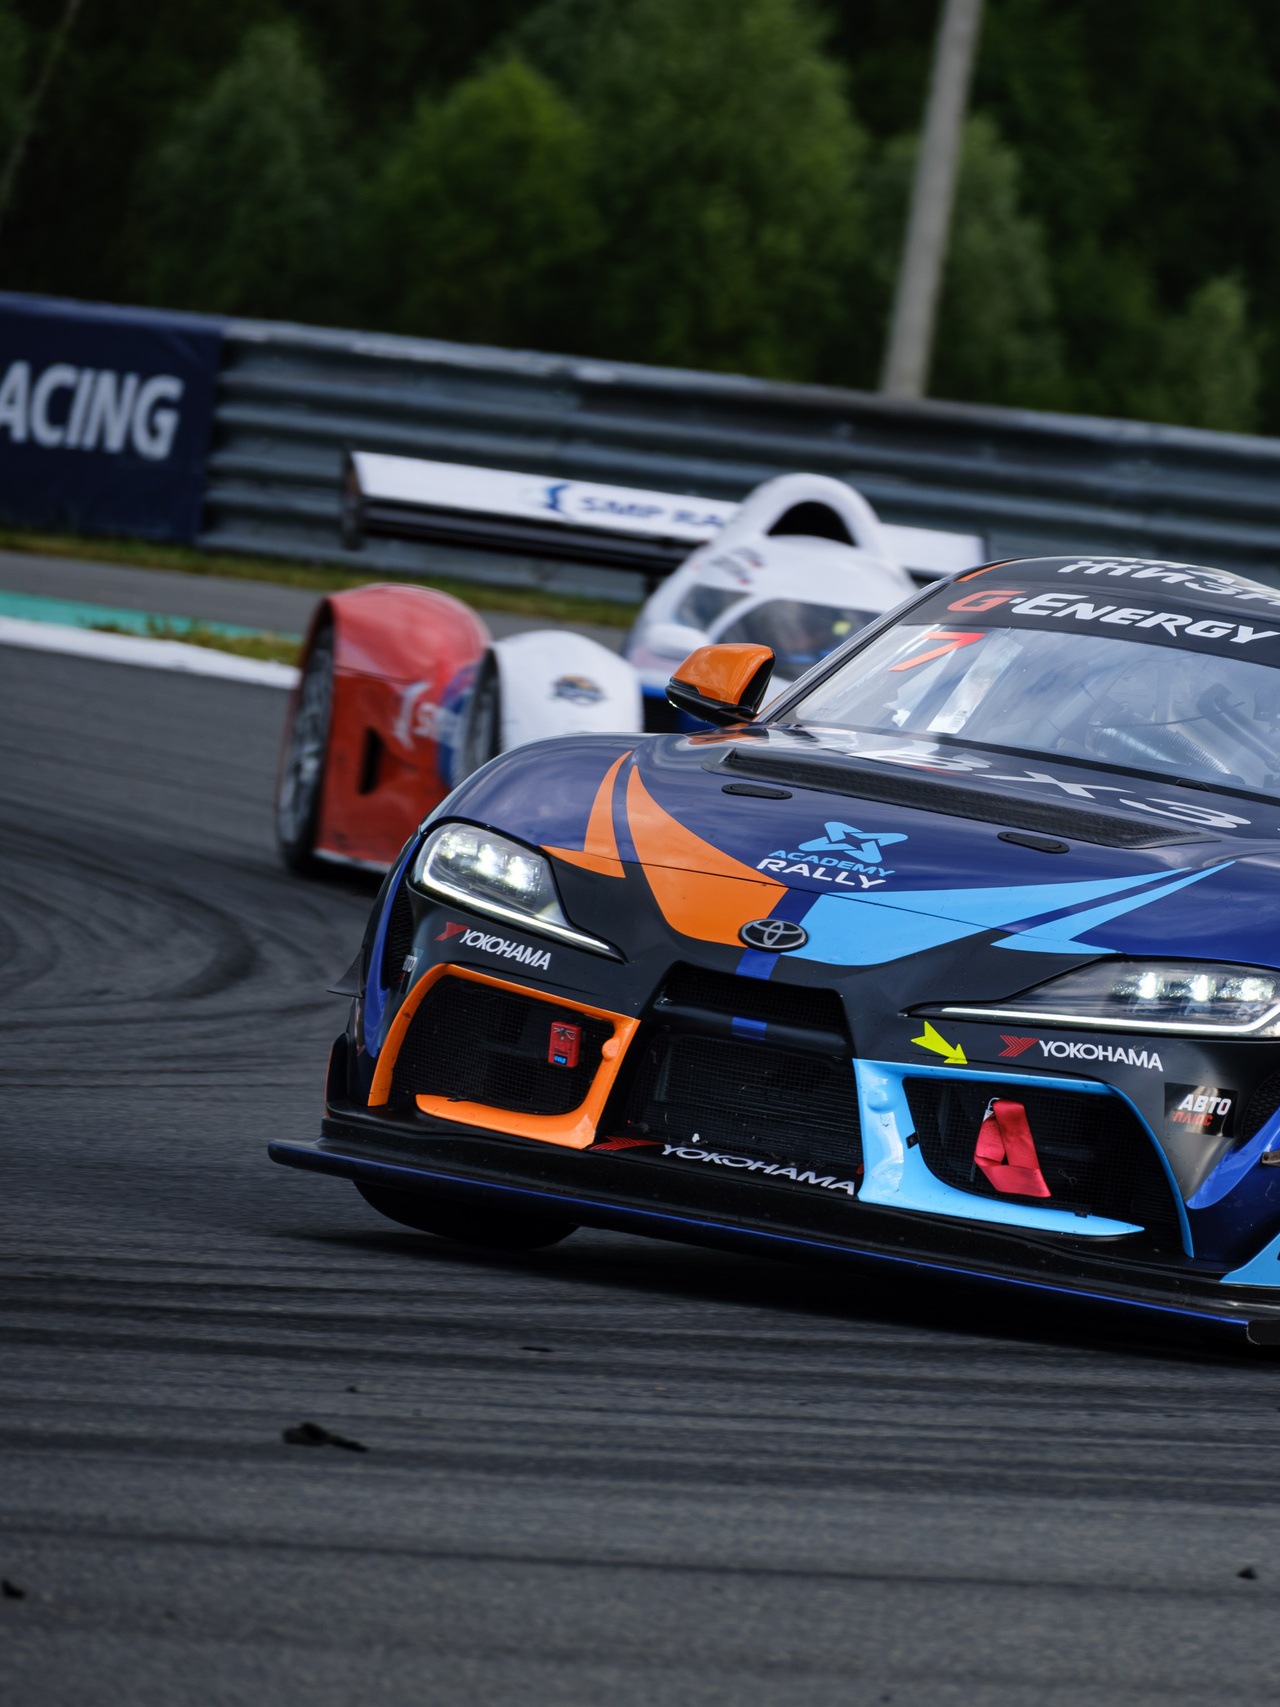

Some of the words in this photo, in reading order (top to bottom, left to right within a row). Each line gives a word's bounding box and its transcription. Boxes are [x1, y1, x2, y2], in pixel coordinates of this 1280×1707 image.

[888, 631, 987, 672] 7
[756, 858, 886, 889] RALLY
[768, 850, 896, 877] ACADEMY
[459, 929, 552, 971] YOKOHAMA
[1039, 1040, 1163, 1071] YOKOHAMA
[1172, 1110, 1213, 1127] ПЛЮС
[1178, 1093, 1231, 1116] АВТО
[661, 1144, 856, 1196] YOKOHAMA
